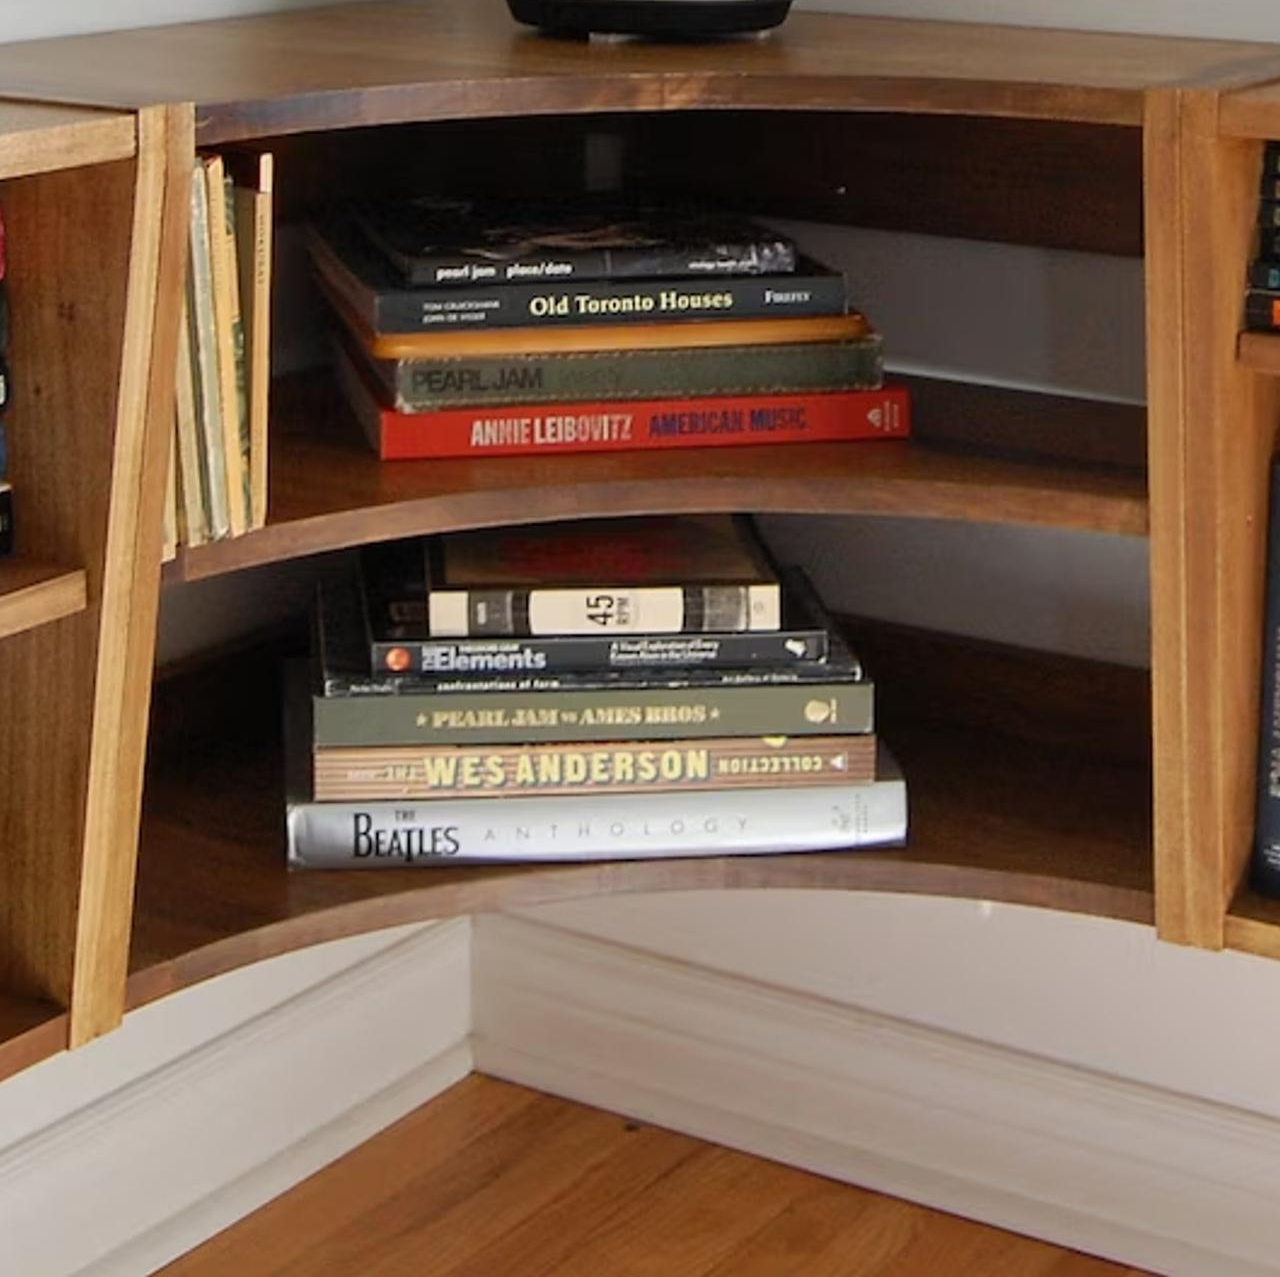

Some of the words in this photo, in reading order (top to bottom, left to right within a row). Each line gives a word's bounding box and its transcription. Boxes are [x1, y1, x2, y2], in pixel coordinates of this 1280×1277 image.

[436, 265, 469, 282] pearl
[471, 264, 496, 280] jam
[506, 261, 572, 279] place/date
[529, 296, 569, 316] Old
[575, 294, 654, 314] Toronto
[660, 290, 733, 311] Houses
[412, 370, 487, 393] PEARL
[492, 368, 543, 390] JAM
[470, 417, 531, 447] ANNIE
[533, 413, 633, 443] LEIBOVITZ
[649, 410, 744, 438] AMERICAN
[749, 407, 808, 433] MUSIC
[586, 594, 614, 626] 45
[616, 597, 630, 624] RPM
[435, 647, 546, 671] Elements
[433, 709, 509, 727] PEARL
[511, 708, 559, 726] JAM
[580, 706, 642, 725] AMES
[644, 705, 707, 724] BROS
[424, 754, 507, 789] WES
[515, 748, 711, 786] ANDERSON
[718, 755, 823, 774] COLLECTION
[394, 810, 417, 821] THE
[352, 812, 461, 862] BEATLES
[483, 817, 748, 842] ANTHOLOGY
